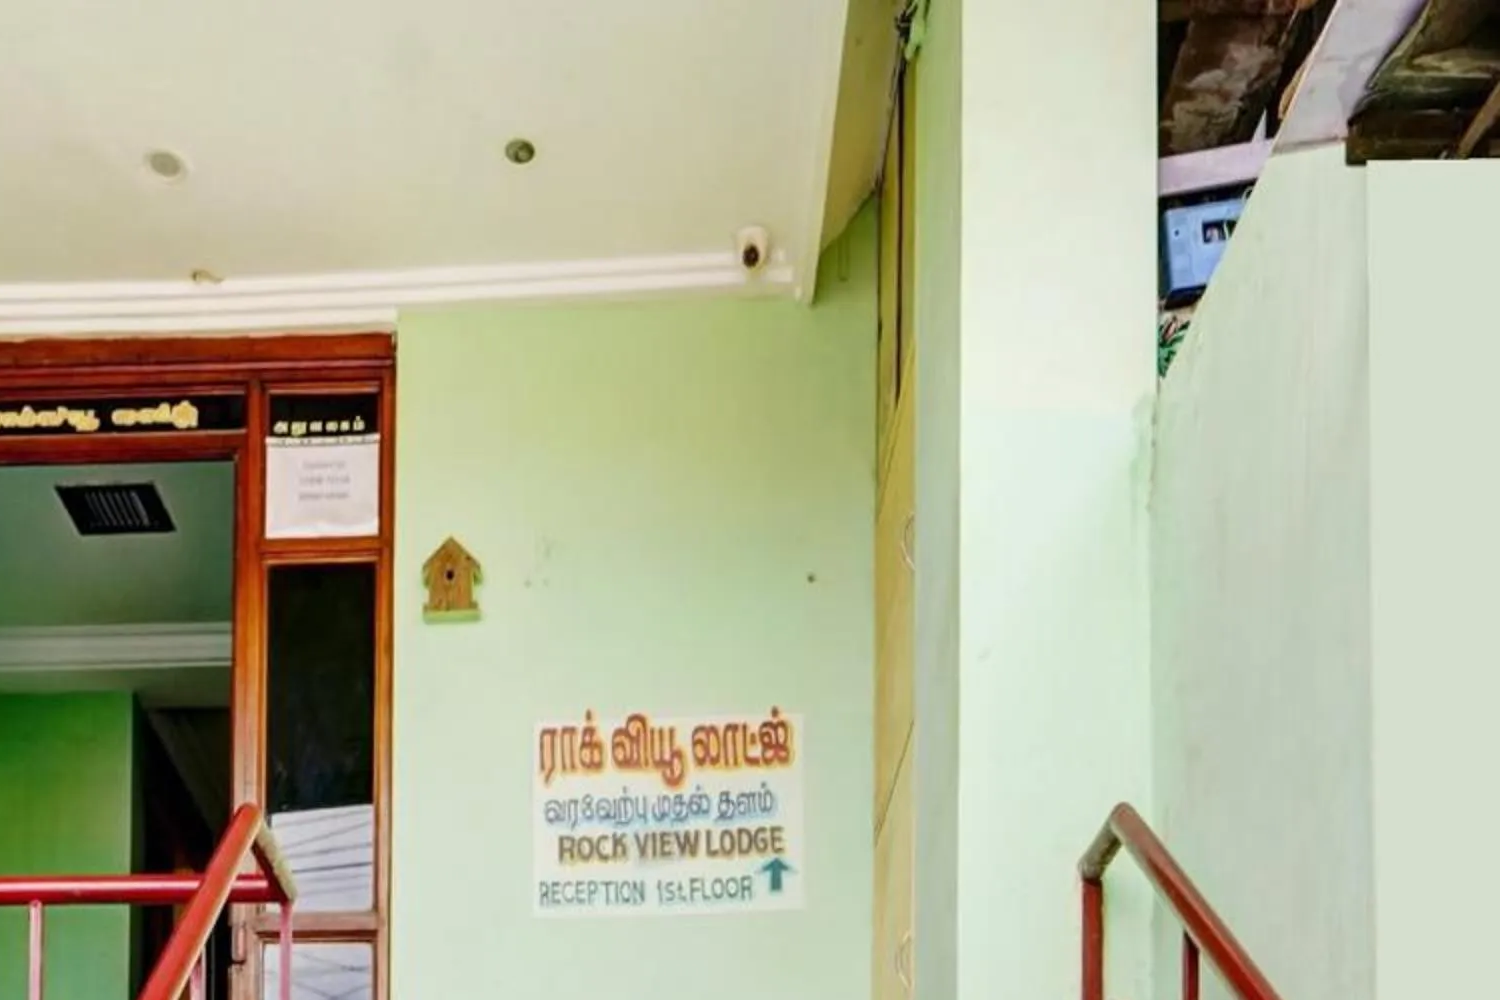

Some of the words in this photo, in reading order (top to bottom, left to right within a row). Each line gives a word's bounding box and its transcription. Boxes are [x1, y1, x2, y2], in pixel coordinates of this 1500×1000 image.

[539, 709, 604, 786] ராக்
[611, 713, 685, 788] வியூ
[558, 832, 628, 863] ROCK
[634, 830, 700, 859] VIEW
[705, 826, 785, 857] LODGE
[539, 880, 645, 907] RECEPTION
[689, 876, 753, 902] FLOOR
